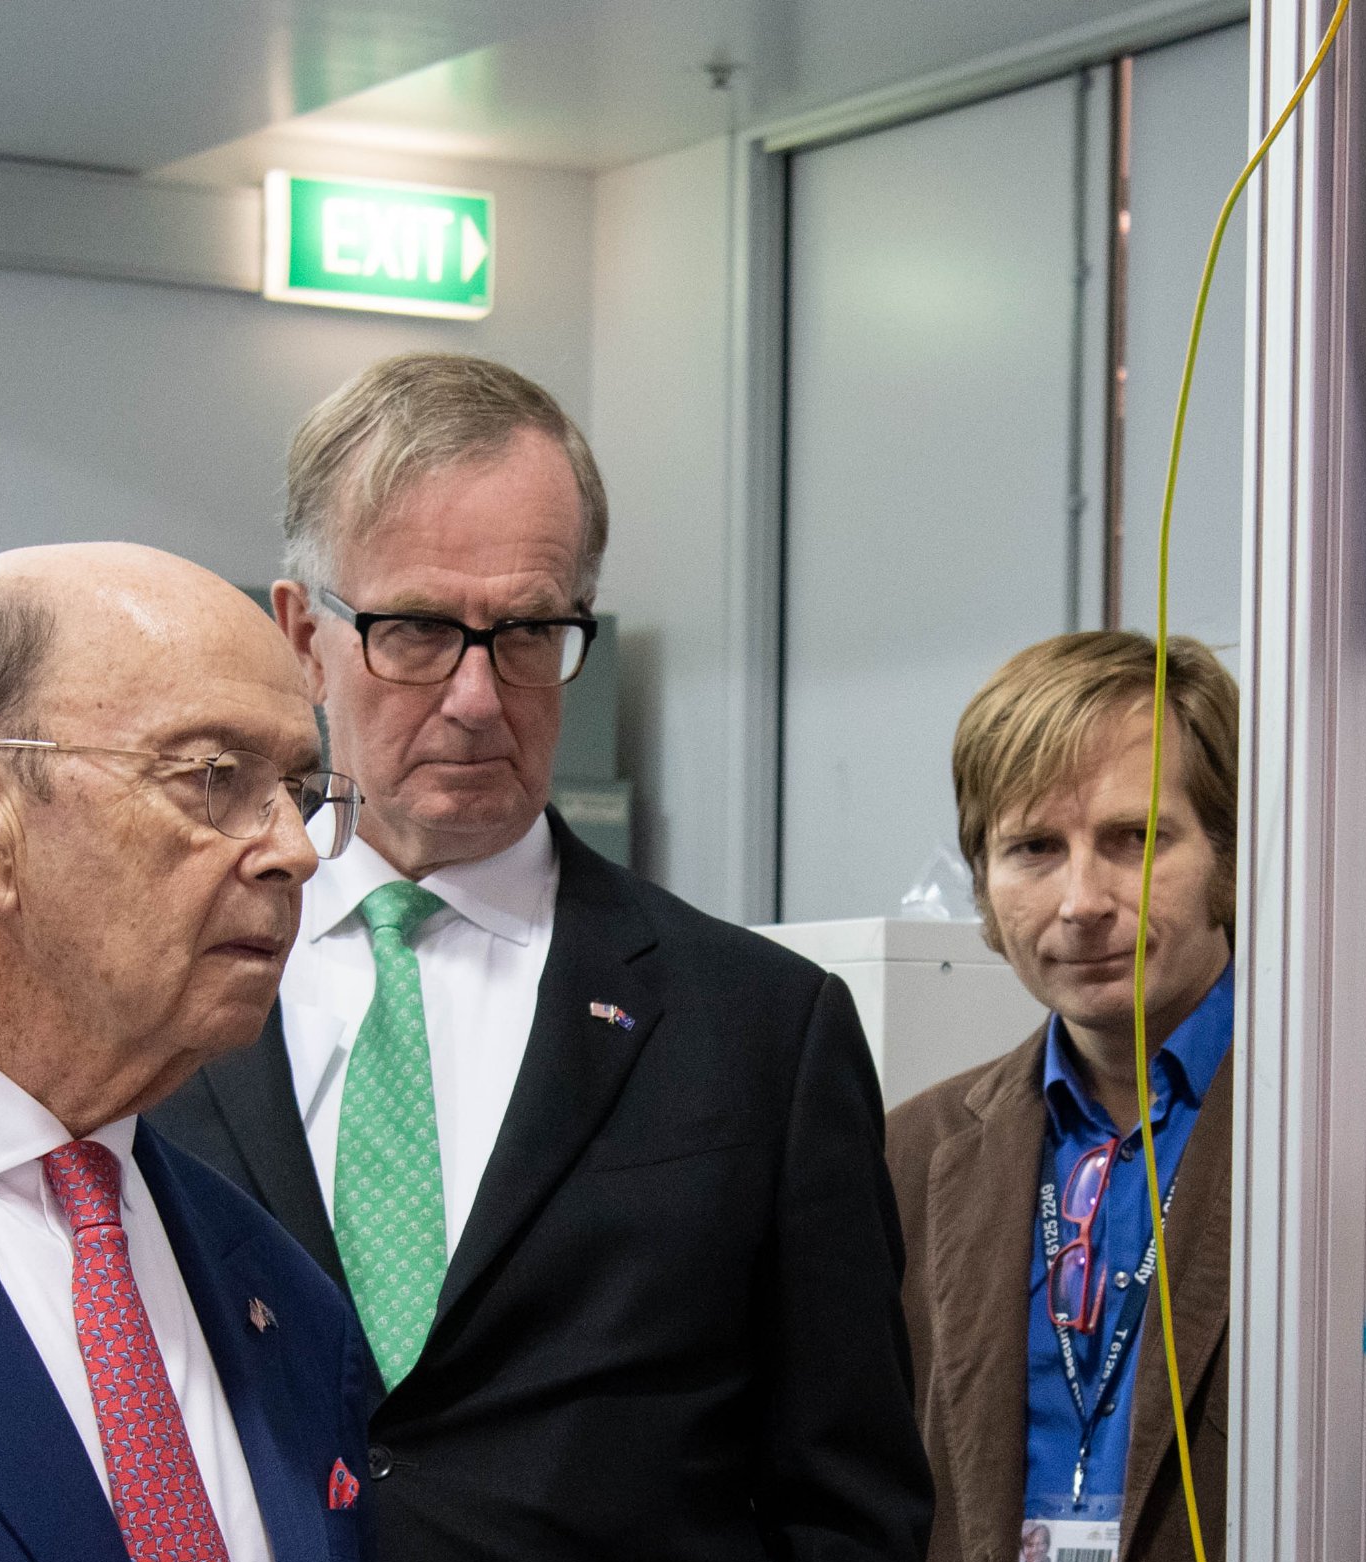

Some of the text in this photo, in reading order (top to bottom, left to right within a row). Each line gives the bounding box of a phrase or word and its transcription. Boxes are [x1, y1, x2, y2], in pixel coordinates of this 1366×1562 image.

[323, 196, 455, 283] EXIT
[1041, 1184, 1056, 1218] 2249
[1045, 1221, 1059, 1255] 6125
[1119, 1329, 1128, 1340] T
